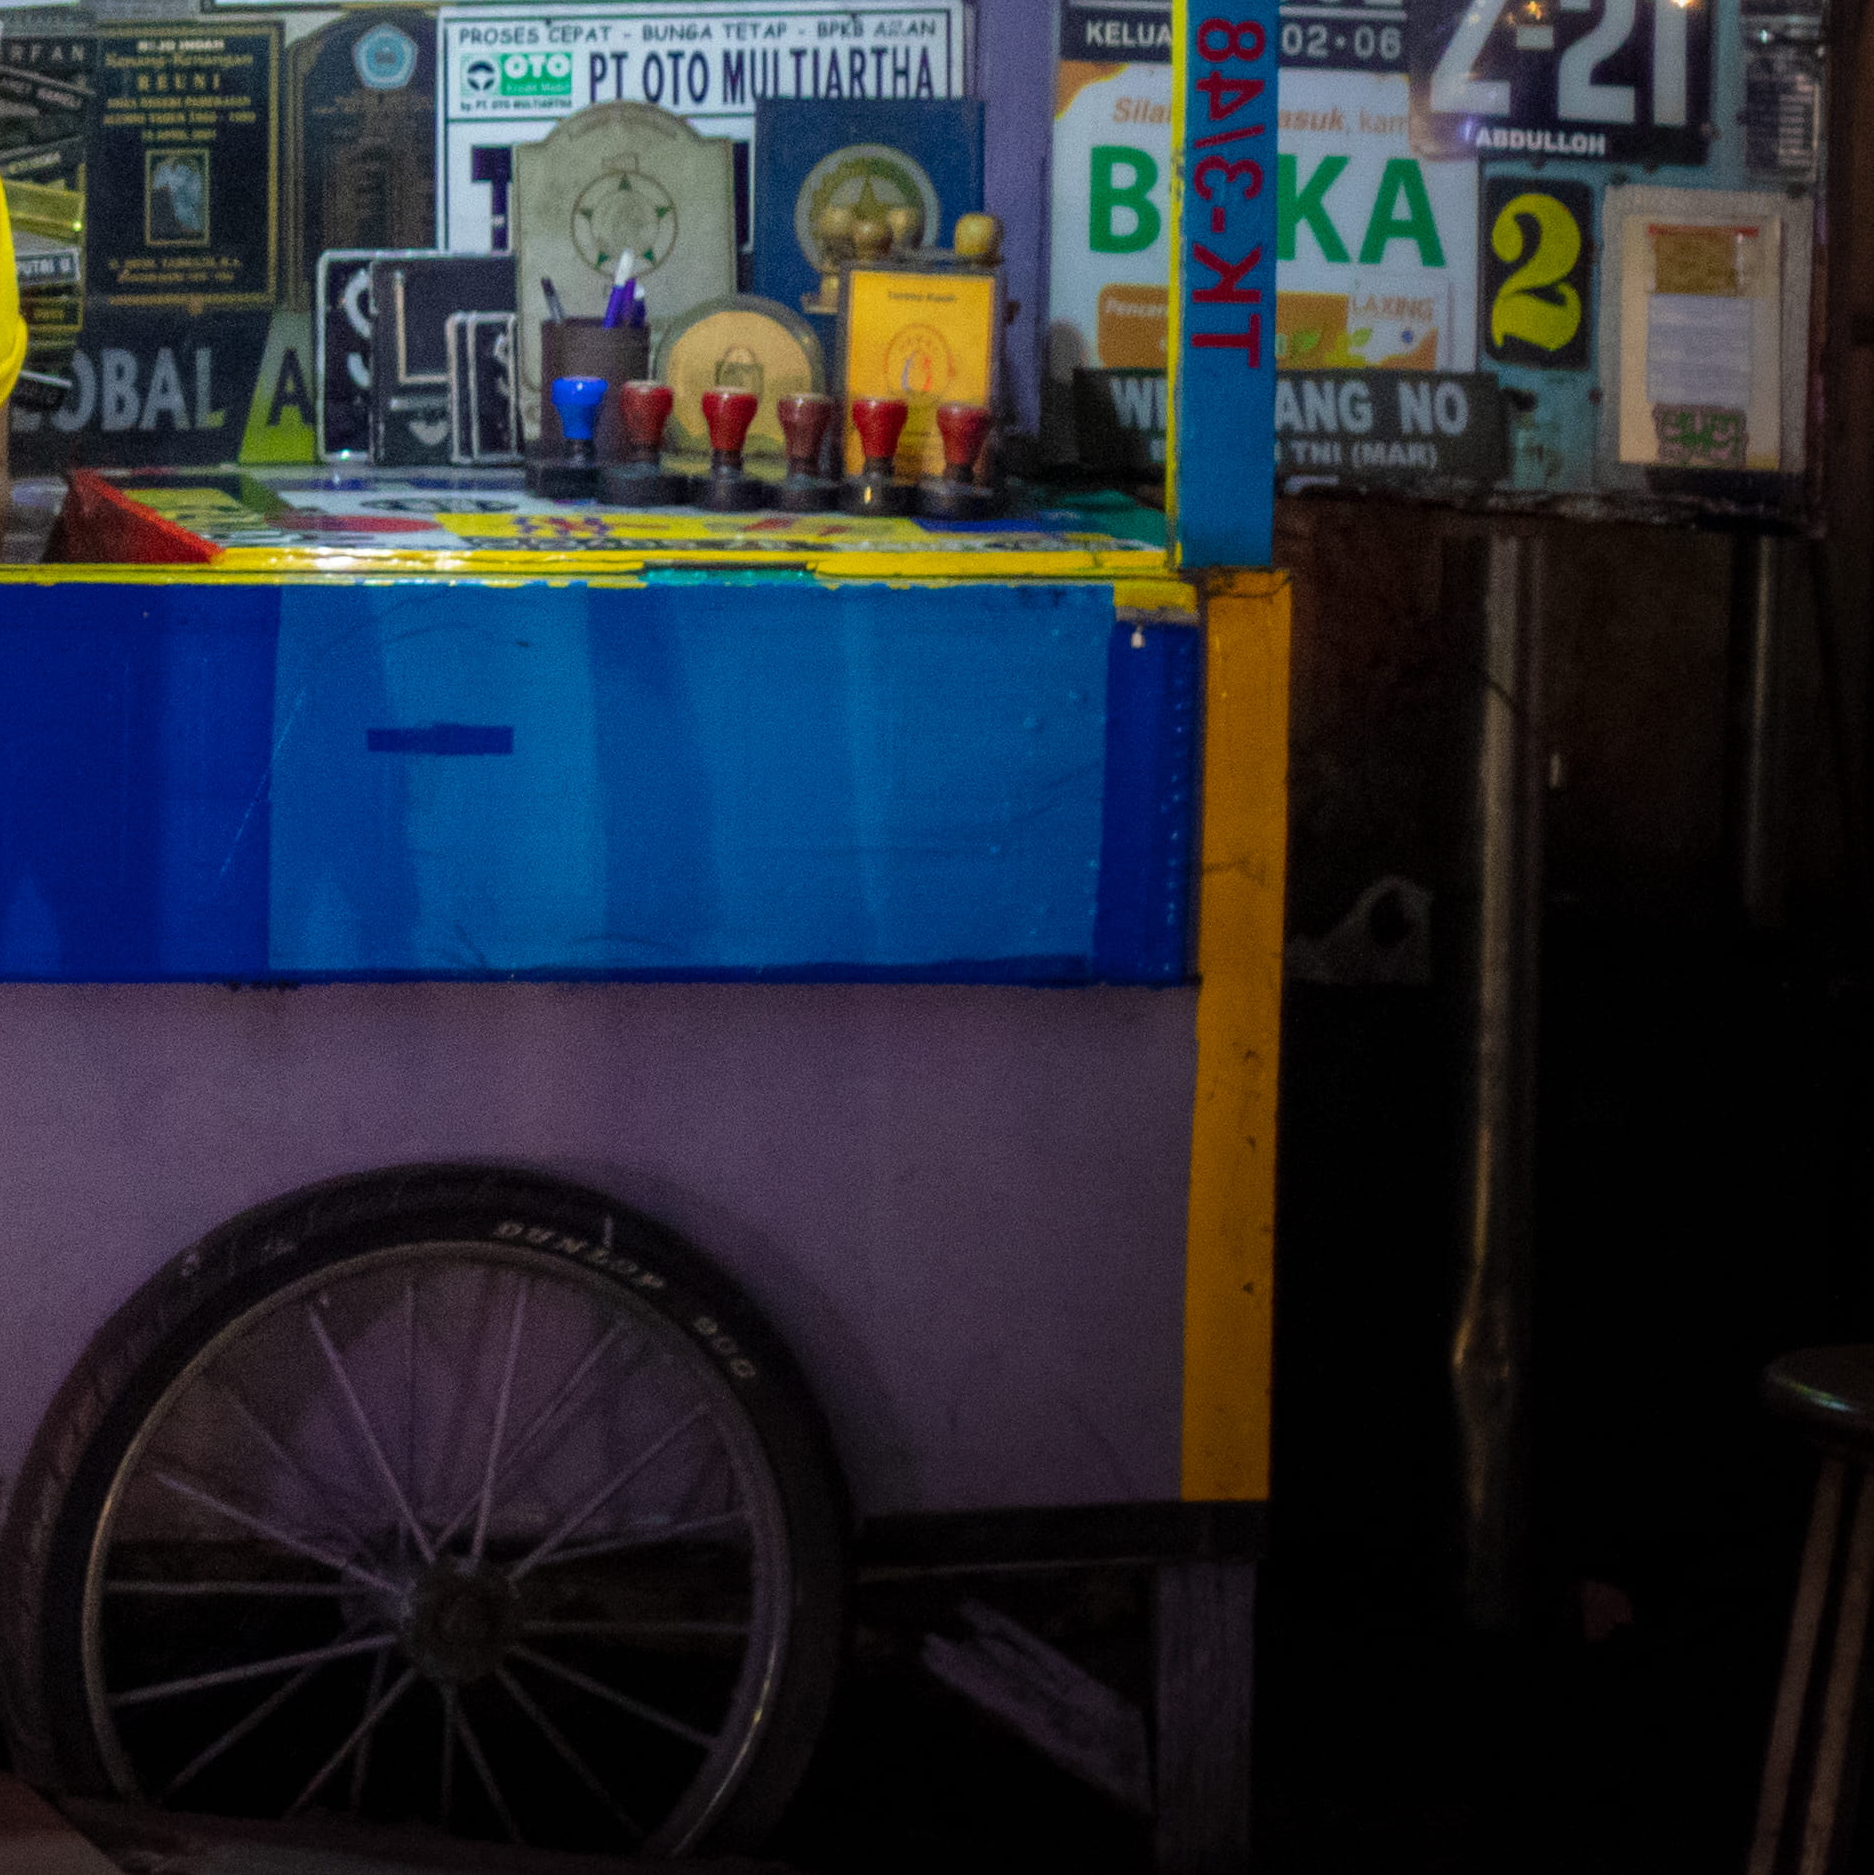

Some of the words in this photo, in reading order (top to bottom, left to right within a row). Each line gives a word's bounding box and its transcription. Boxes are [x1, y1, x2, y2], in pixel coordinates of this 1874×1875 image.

[459, 26, 540, 46] PROSES
[549, 25, 610, 45] CEPAT
[642, 23, 712, 43] BUNGA
[724, 21, 787, 42] TETAP
[817, 20, 865, 40] BPKB
[502, 52, 572, 80] OTO
[590, 52, 629, 105] PT
[642, 51, 710, 106] OTO
[723, 46, 937, 105] MULTIARTHA
[137, 73, 221, 92] REUNI
[1474, 127, 1608, 158] ABDULLOH
[1089, 145, 1447, 268] BKA
[1490, 192, 1584, 354] 2
[1397, 379, 1470, 436] NO
[1294, 440, 1343, 468] TNI
[1351, 439, 1439, 470] (MAR)
